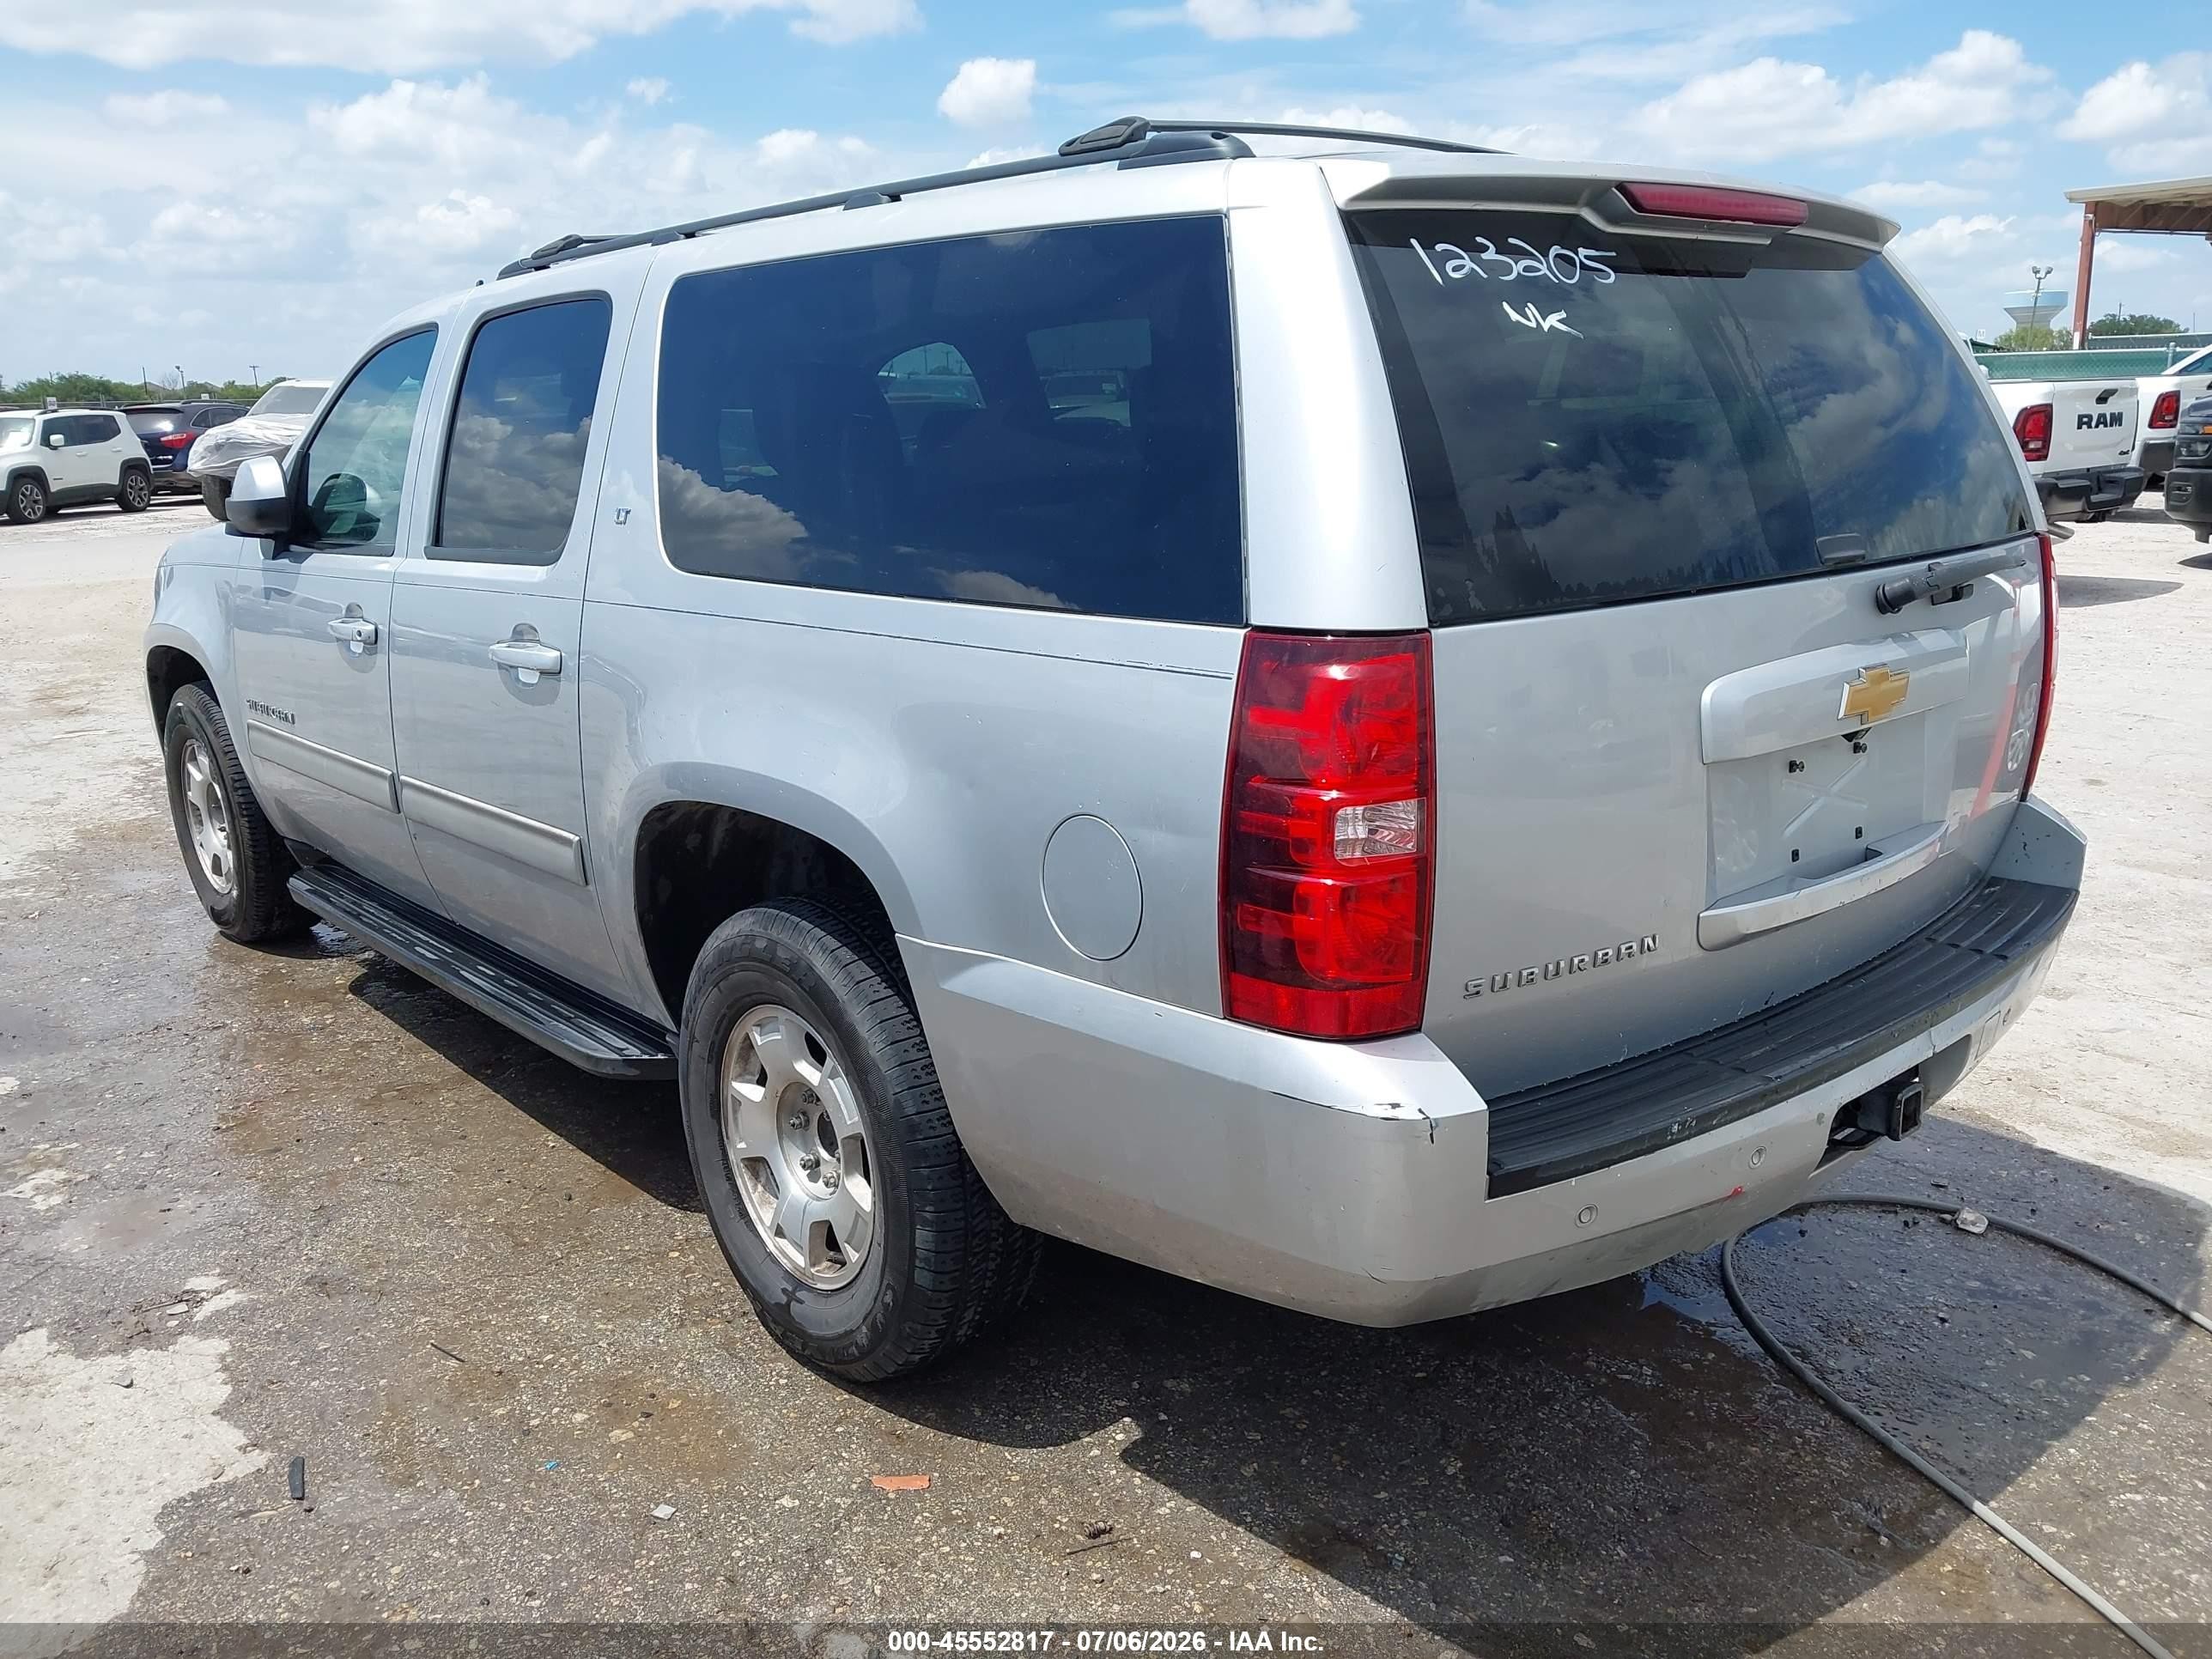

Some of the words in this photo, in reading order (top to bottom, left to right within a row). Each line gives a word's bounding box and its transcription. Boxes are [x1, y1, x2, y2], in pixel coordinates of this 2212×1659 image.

[1410, 236, 1617, 287] 123205
[2076, 410, 2124, 430] RAM
[614, 507, 632, 526] LT
[1462, 933, 1660, 1000] SUBURBAN
